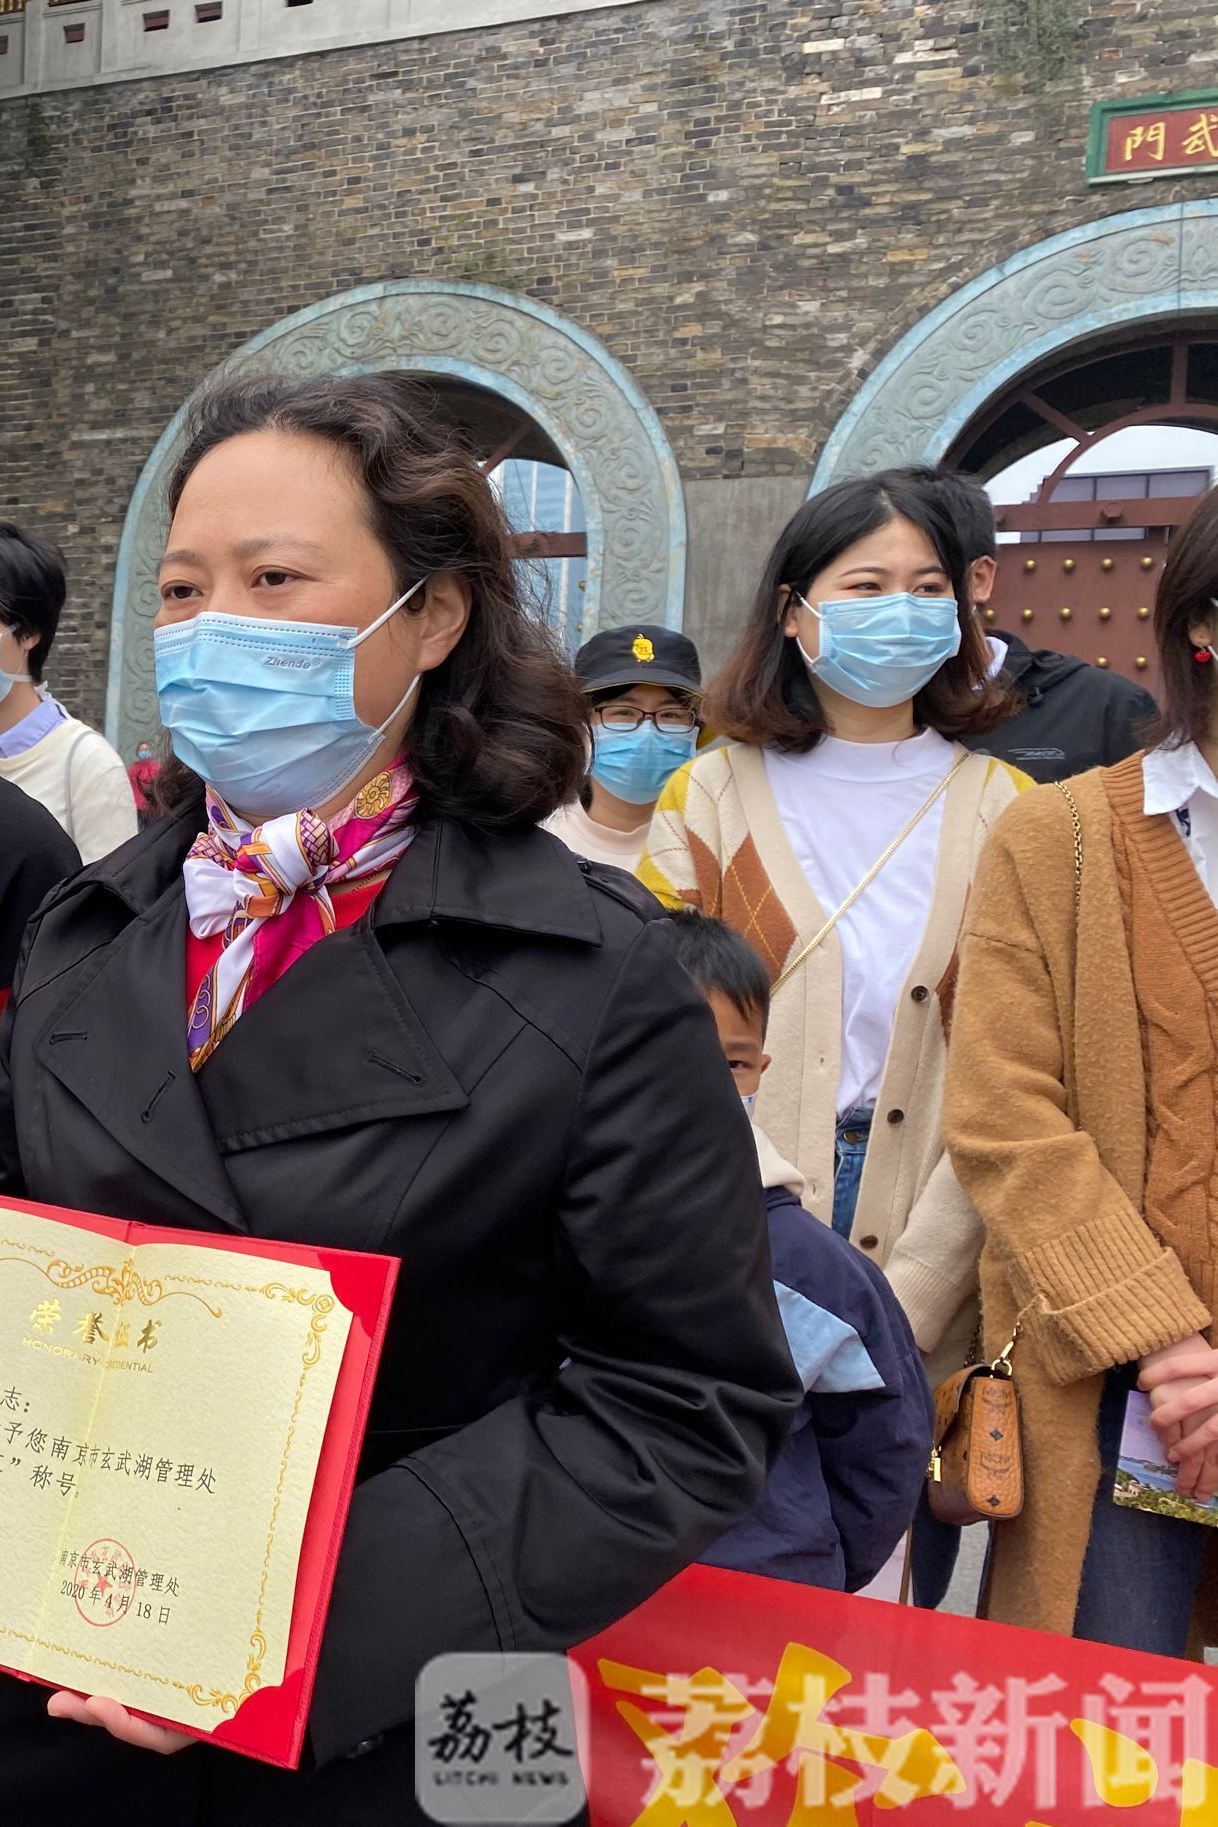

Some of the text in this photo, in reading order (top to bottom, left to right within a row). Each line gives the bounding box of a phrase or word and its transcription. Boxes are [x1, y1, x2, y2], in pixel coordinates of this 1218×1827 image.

[263, 656, 311, 670] Zhende
[22, 1337, 102, 1366] HONORARY
[60, 1548, 181, 1598] 南京市玄武湖管理处
